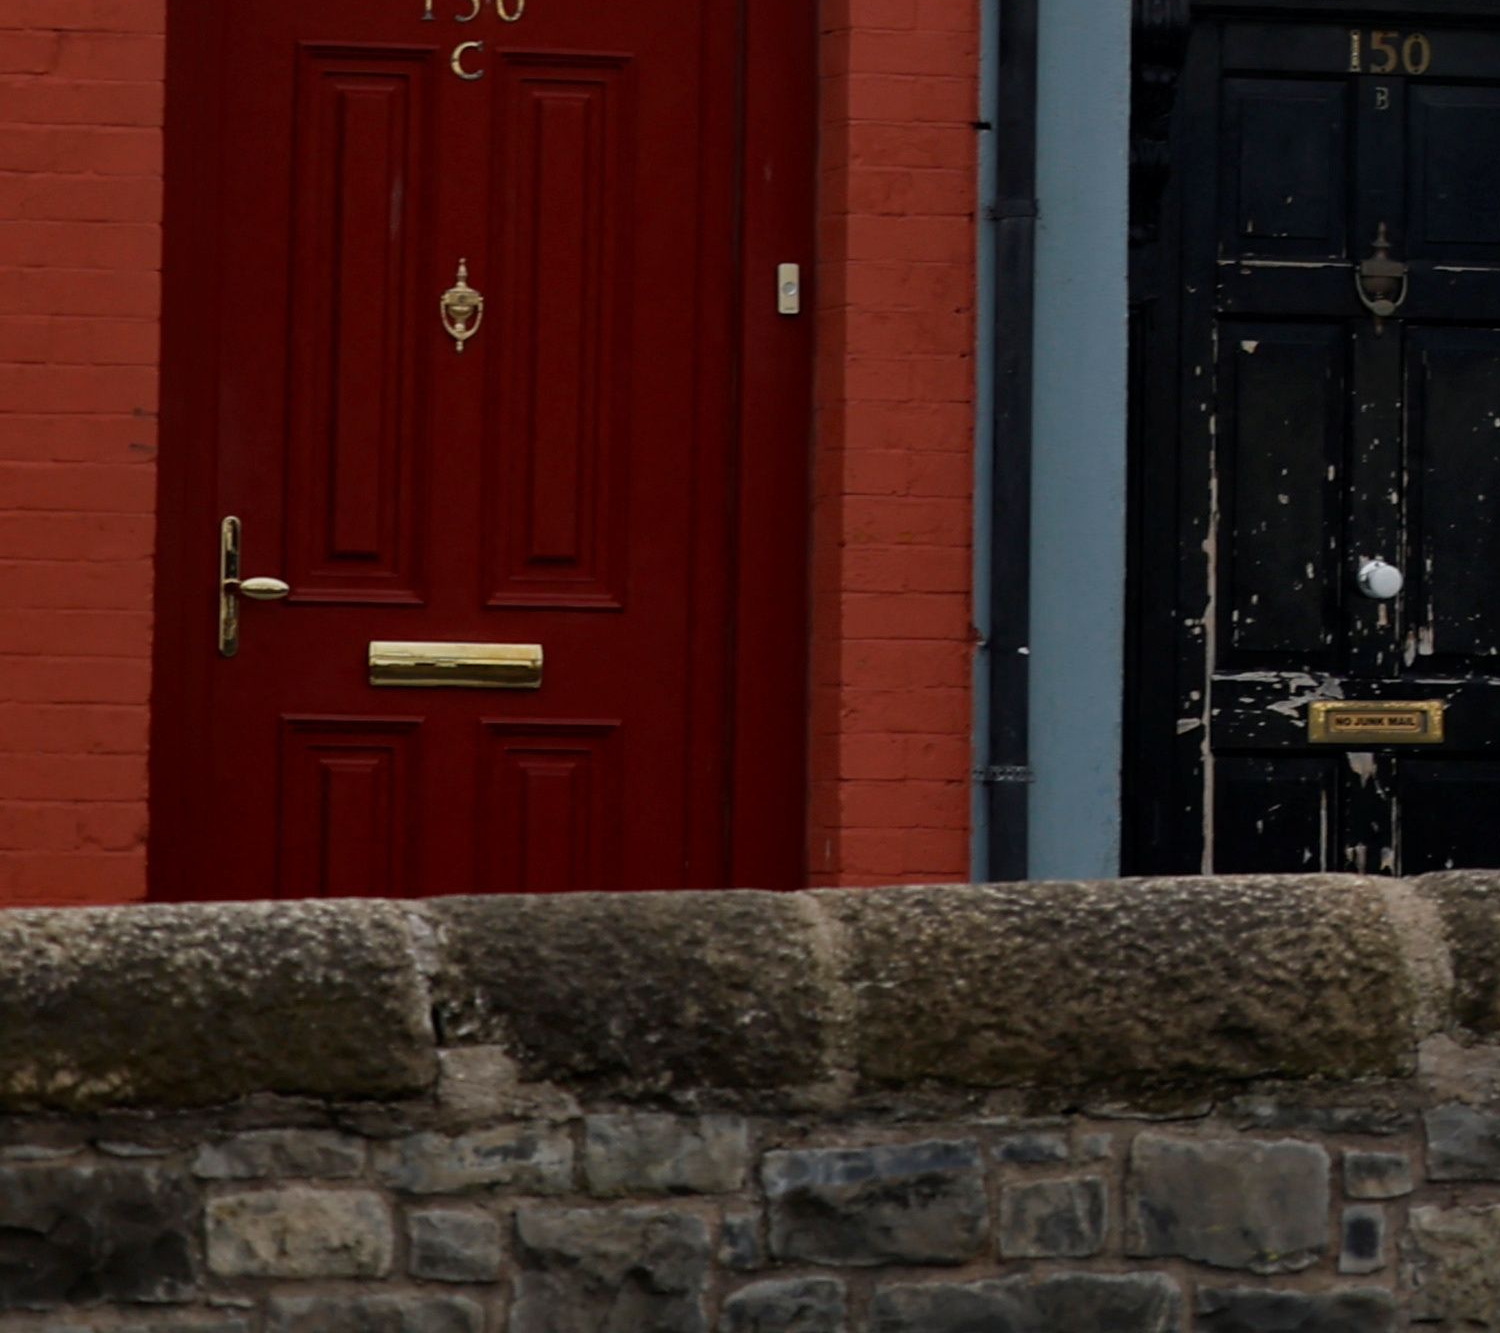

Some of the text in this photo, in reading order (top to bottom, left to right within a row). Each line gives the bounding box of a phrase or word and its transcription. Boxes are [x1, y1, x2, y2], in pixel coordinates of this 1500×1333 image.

[451, 39, 484, 80] C
[1348, 30, 1432, 75] 150
[1375, 86, 1391, 110] B
[1335, 717, 1416, 727] NO JUNK MAIL
